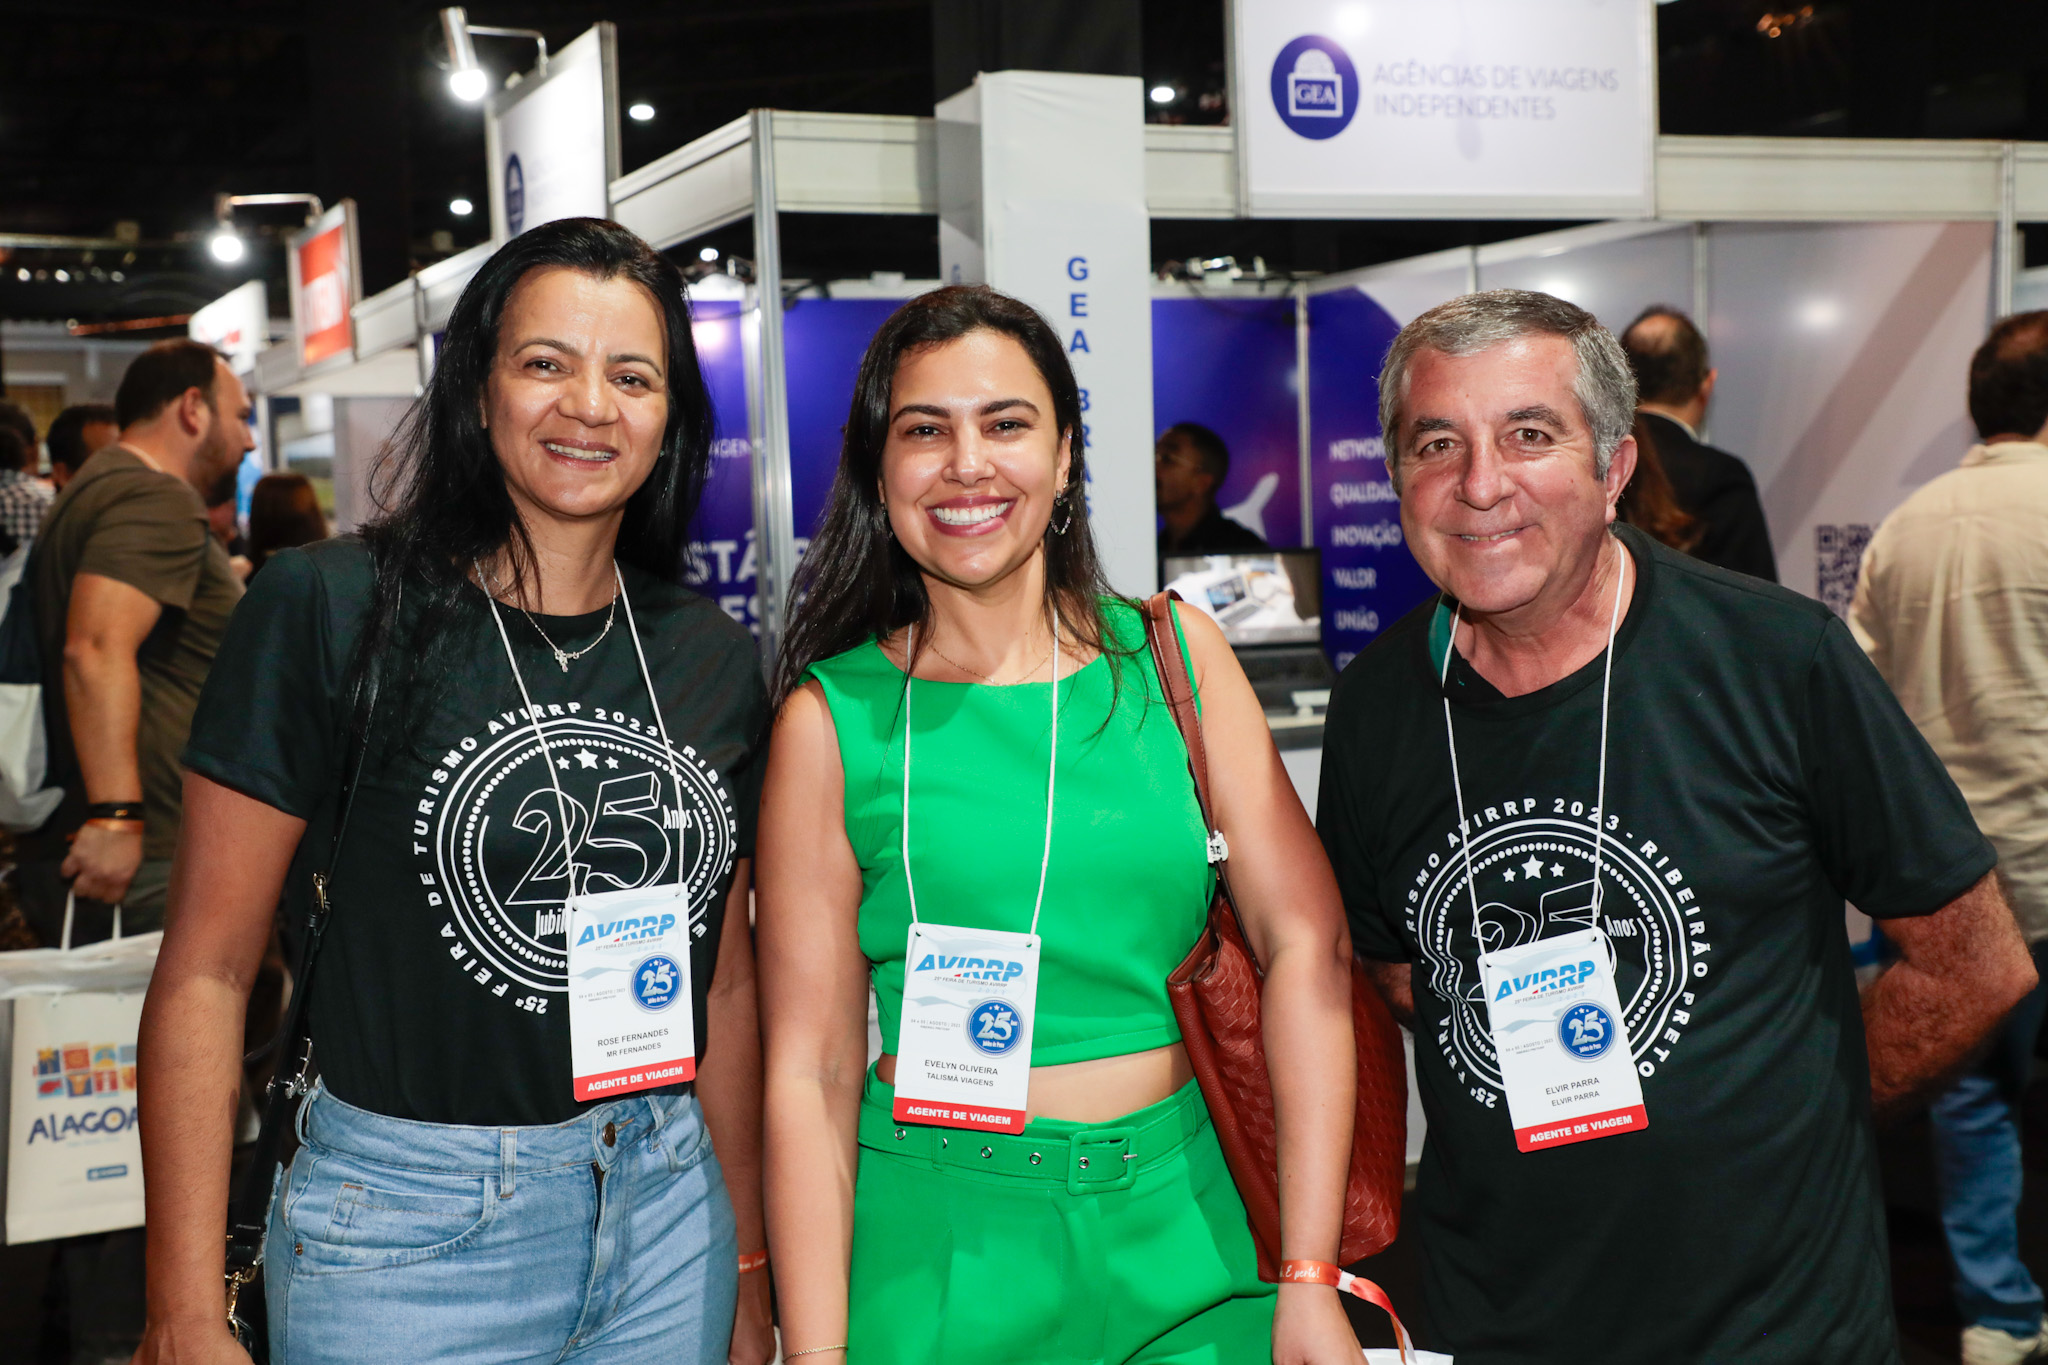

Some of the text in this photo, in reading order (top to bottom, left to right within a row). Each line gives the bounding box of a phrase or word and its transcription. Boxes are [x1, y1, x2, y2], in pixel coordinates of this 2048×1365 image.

[1373, 60, 1619, 92] AGÊNCIAS DE VIAGENS
[1295, 83, 1336, 104] GEA
[1373, 93, 1556, 120] INDEPENDENTES
[1067, 256, 1091, 354] GEA
[1331, 518, 1403, 551] INOVAÇÃO
[1332, 567, 1377, 589] VALOR
[1334, 604, 1379, 633] UNIÃO
[487, 702, 581, 735] AVIRRP
[595, 707, 659, 738] 2023
[413, 736, 478, 856] TURISMO
[1447, 797, 1537, 849] AVIRRP
[1553, 798, 1620, 831] 2023
[420, 871, 443, 907] DE
[1640, 840, 1711, 979] RIBEIRÃO
[576, 914, 676, 947] AVIRRP
[1604, 914, 1638, 938] Anos
[440, 922, 509, 997] FEIRA
[914, 954, 1024, 982] AVIRRP
[641, 963, 673, 997] 25
[1494, 960, 1596, 1003] AVIRRP
[1545, 988, 1567, 998] TURISMO
[597, 1028, 669, 1047] ROSE FERNANDES
[976, 1011, 1013, 1041] 25
[1568, 1010, 1605, 1047] 25
[1638, 990, 1696, 1079] PRETO
[606, 1042, 662, 1058] MR FERNANDES
[587, 1066, 684, 1092] AGENTE DE VIAGEM
[924, 1059, 999, 1075] EVELYN OLIVEIRA
[960, 1076, 994, 1087] VIAGENS
[1545, 1077, 1600, 1095] ELVIR PARRA
[1551, 1090, 1600, 1107] ELVIR PARRA
[27, 1106, 140, 1146] ALAGOA
[906, 1106, 1012, 1126] AGENTE DE VIAGEM
[1529, 1115, 1633, 1143] AGENTE DE VIAGEM
